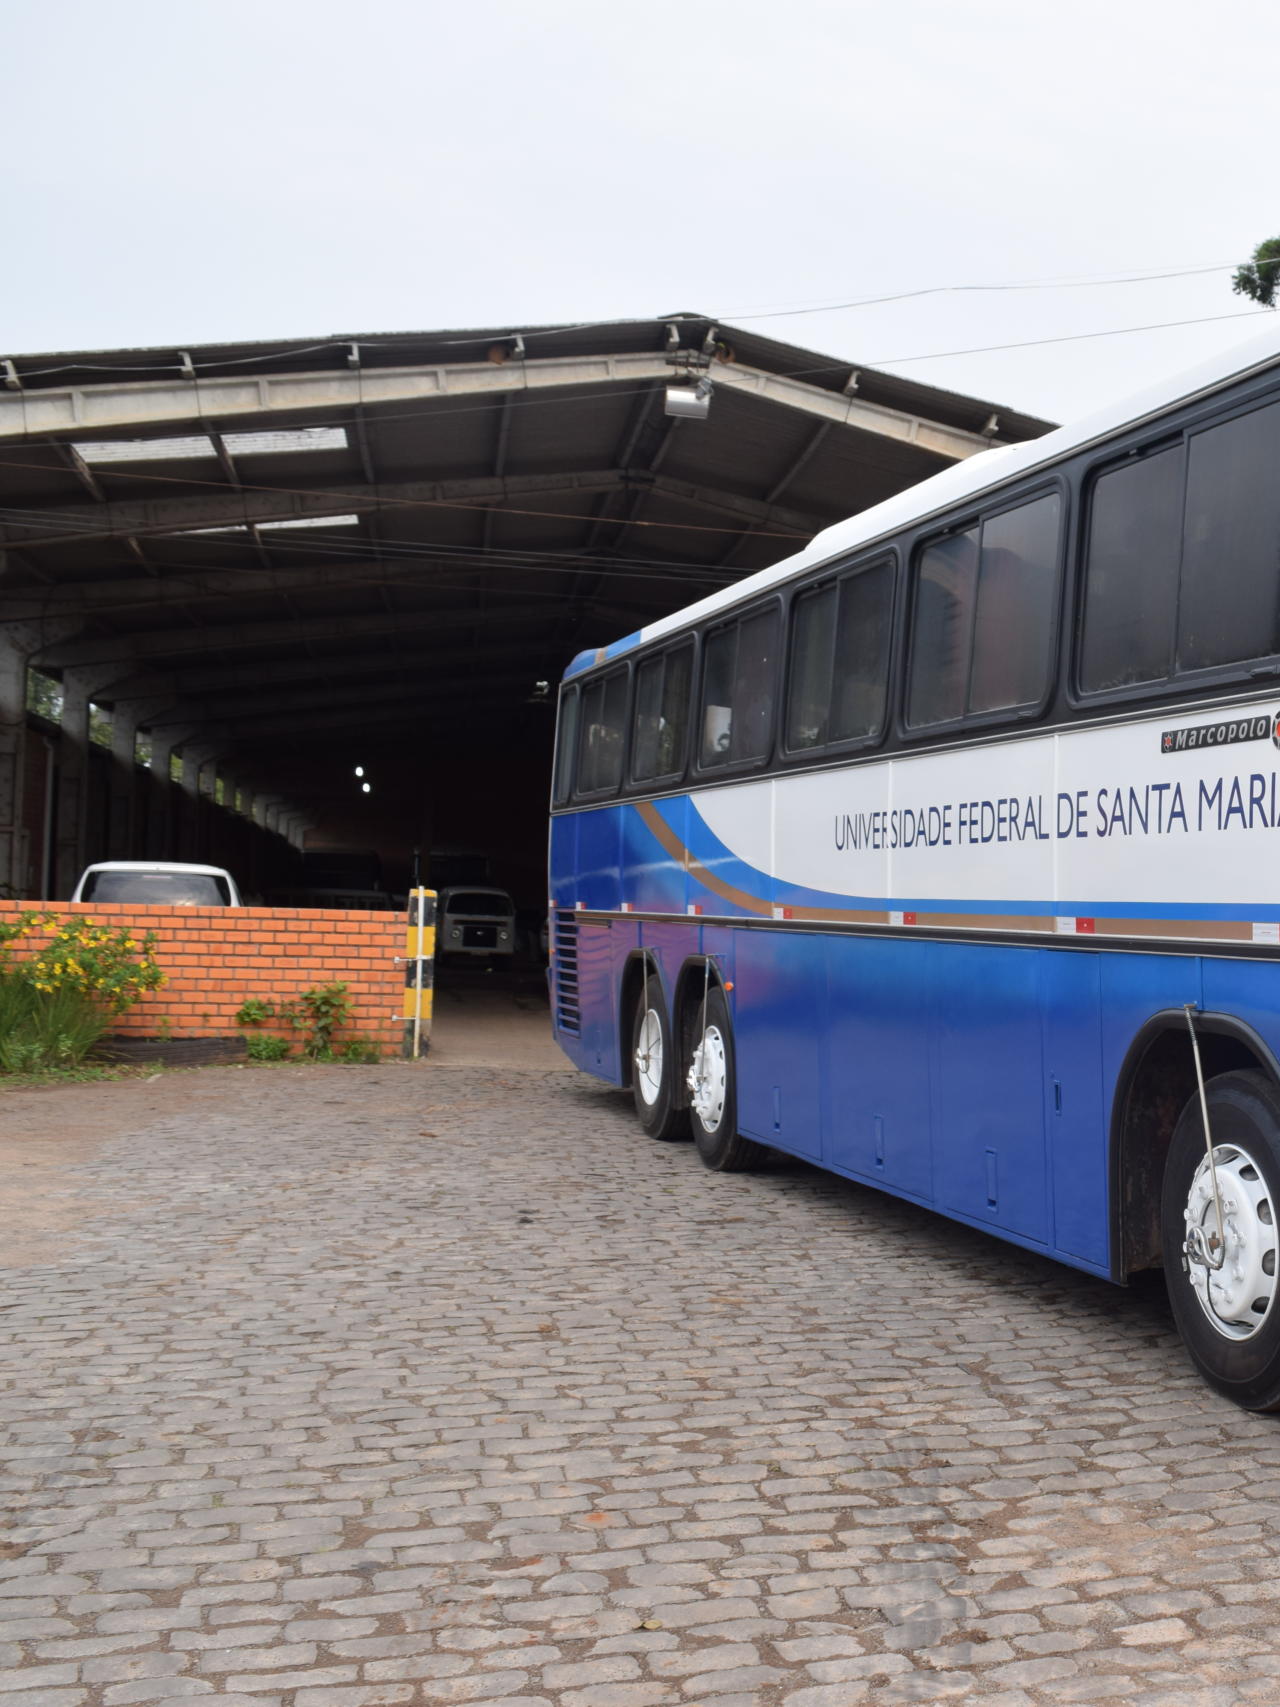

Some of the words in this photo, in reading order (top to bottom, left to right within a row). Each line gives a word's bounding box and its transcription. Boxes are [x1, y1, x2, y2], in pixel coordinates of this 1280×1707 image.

[1175, 718, 1266, 750] Marcopolo
[835, 804, 952, 851] UNIVERSIDADE
[958, 794, 1050, 845] FEDERAL
[1056, 790, 1089, 839] DE
[1096, 782, 1189, 838] SANTA
